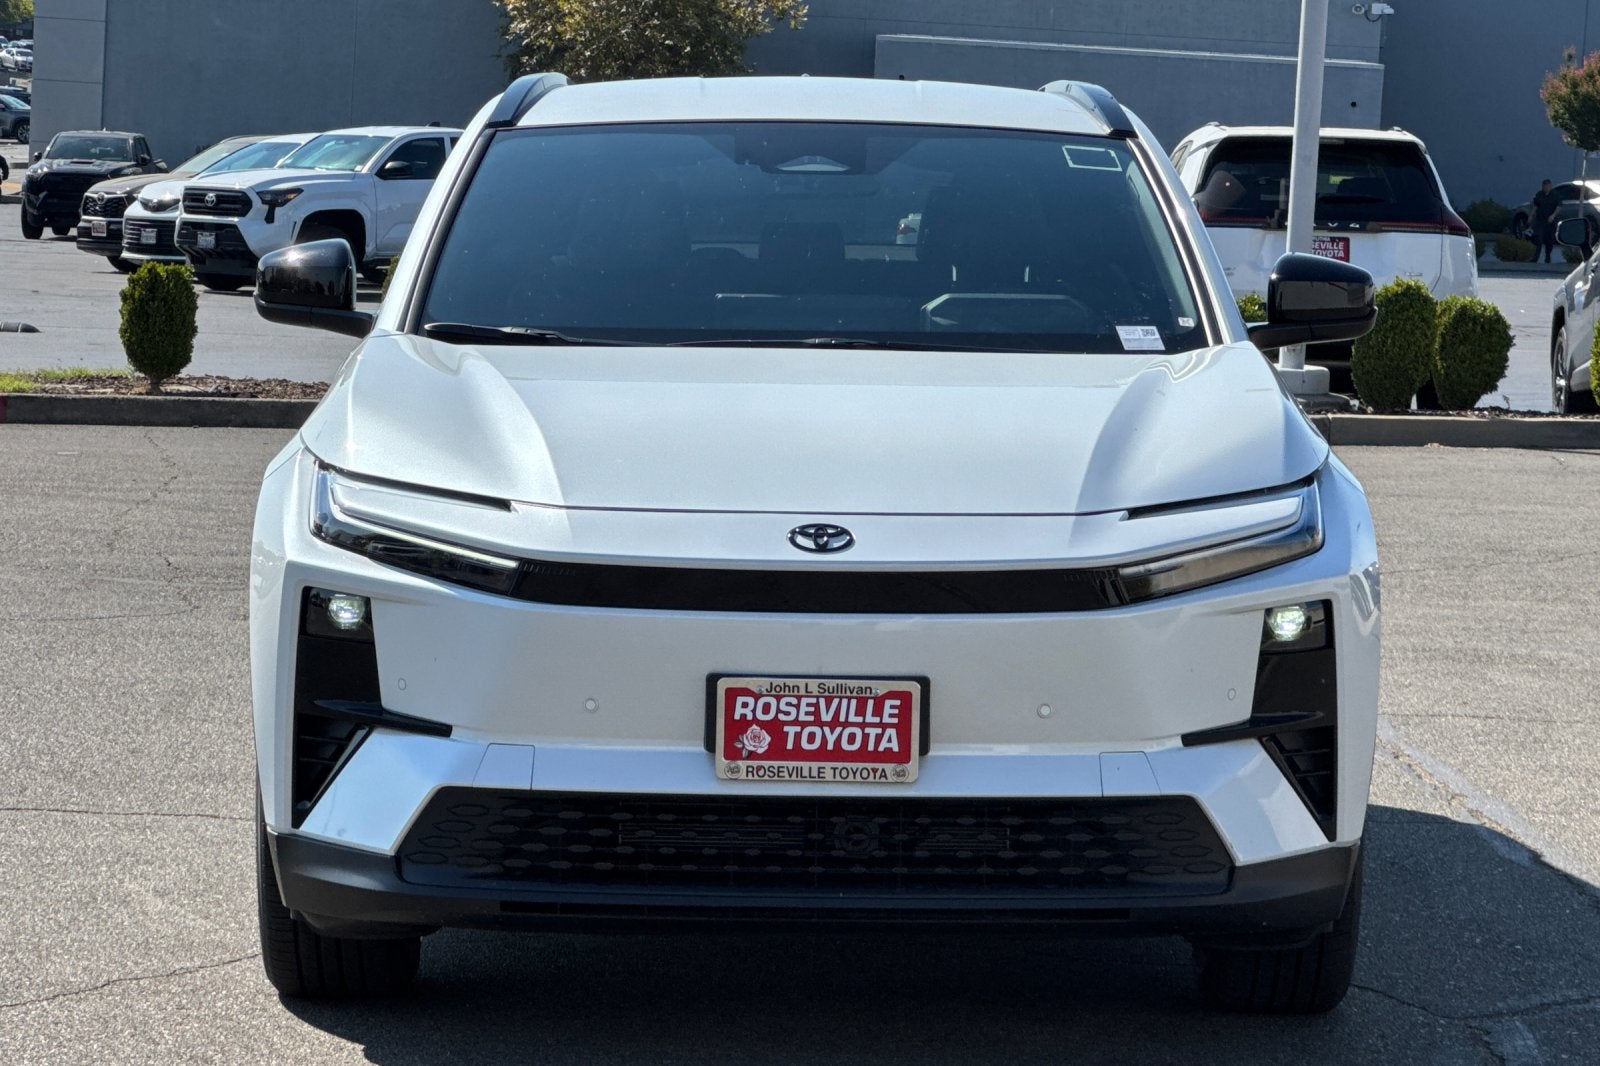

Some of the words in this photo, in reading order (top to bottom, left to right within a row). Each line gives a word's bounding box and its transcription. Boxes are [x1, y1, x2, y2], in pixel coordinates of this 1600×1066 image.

[765, 682, 800, 694] John
[805, 683, 814, 694] L
[817, 682, 873, 695] Sullivan
[733, 696, 901, 724] ROSEVILLE
[783, 725, 899, 753] TOYOTA
[745, 765, 826, 779] ROSEVILLE
[830, 766, 888, 780] TOYOTA
